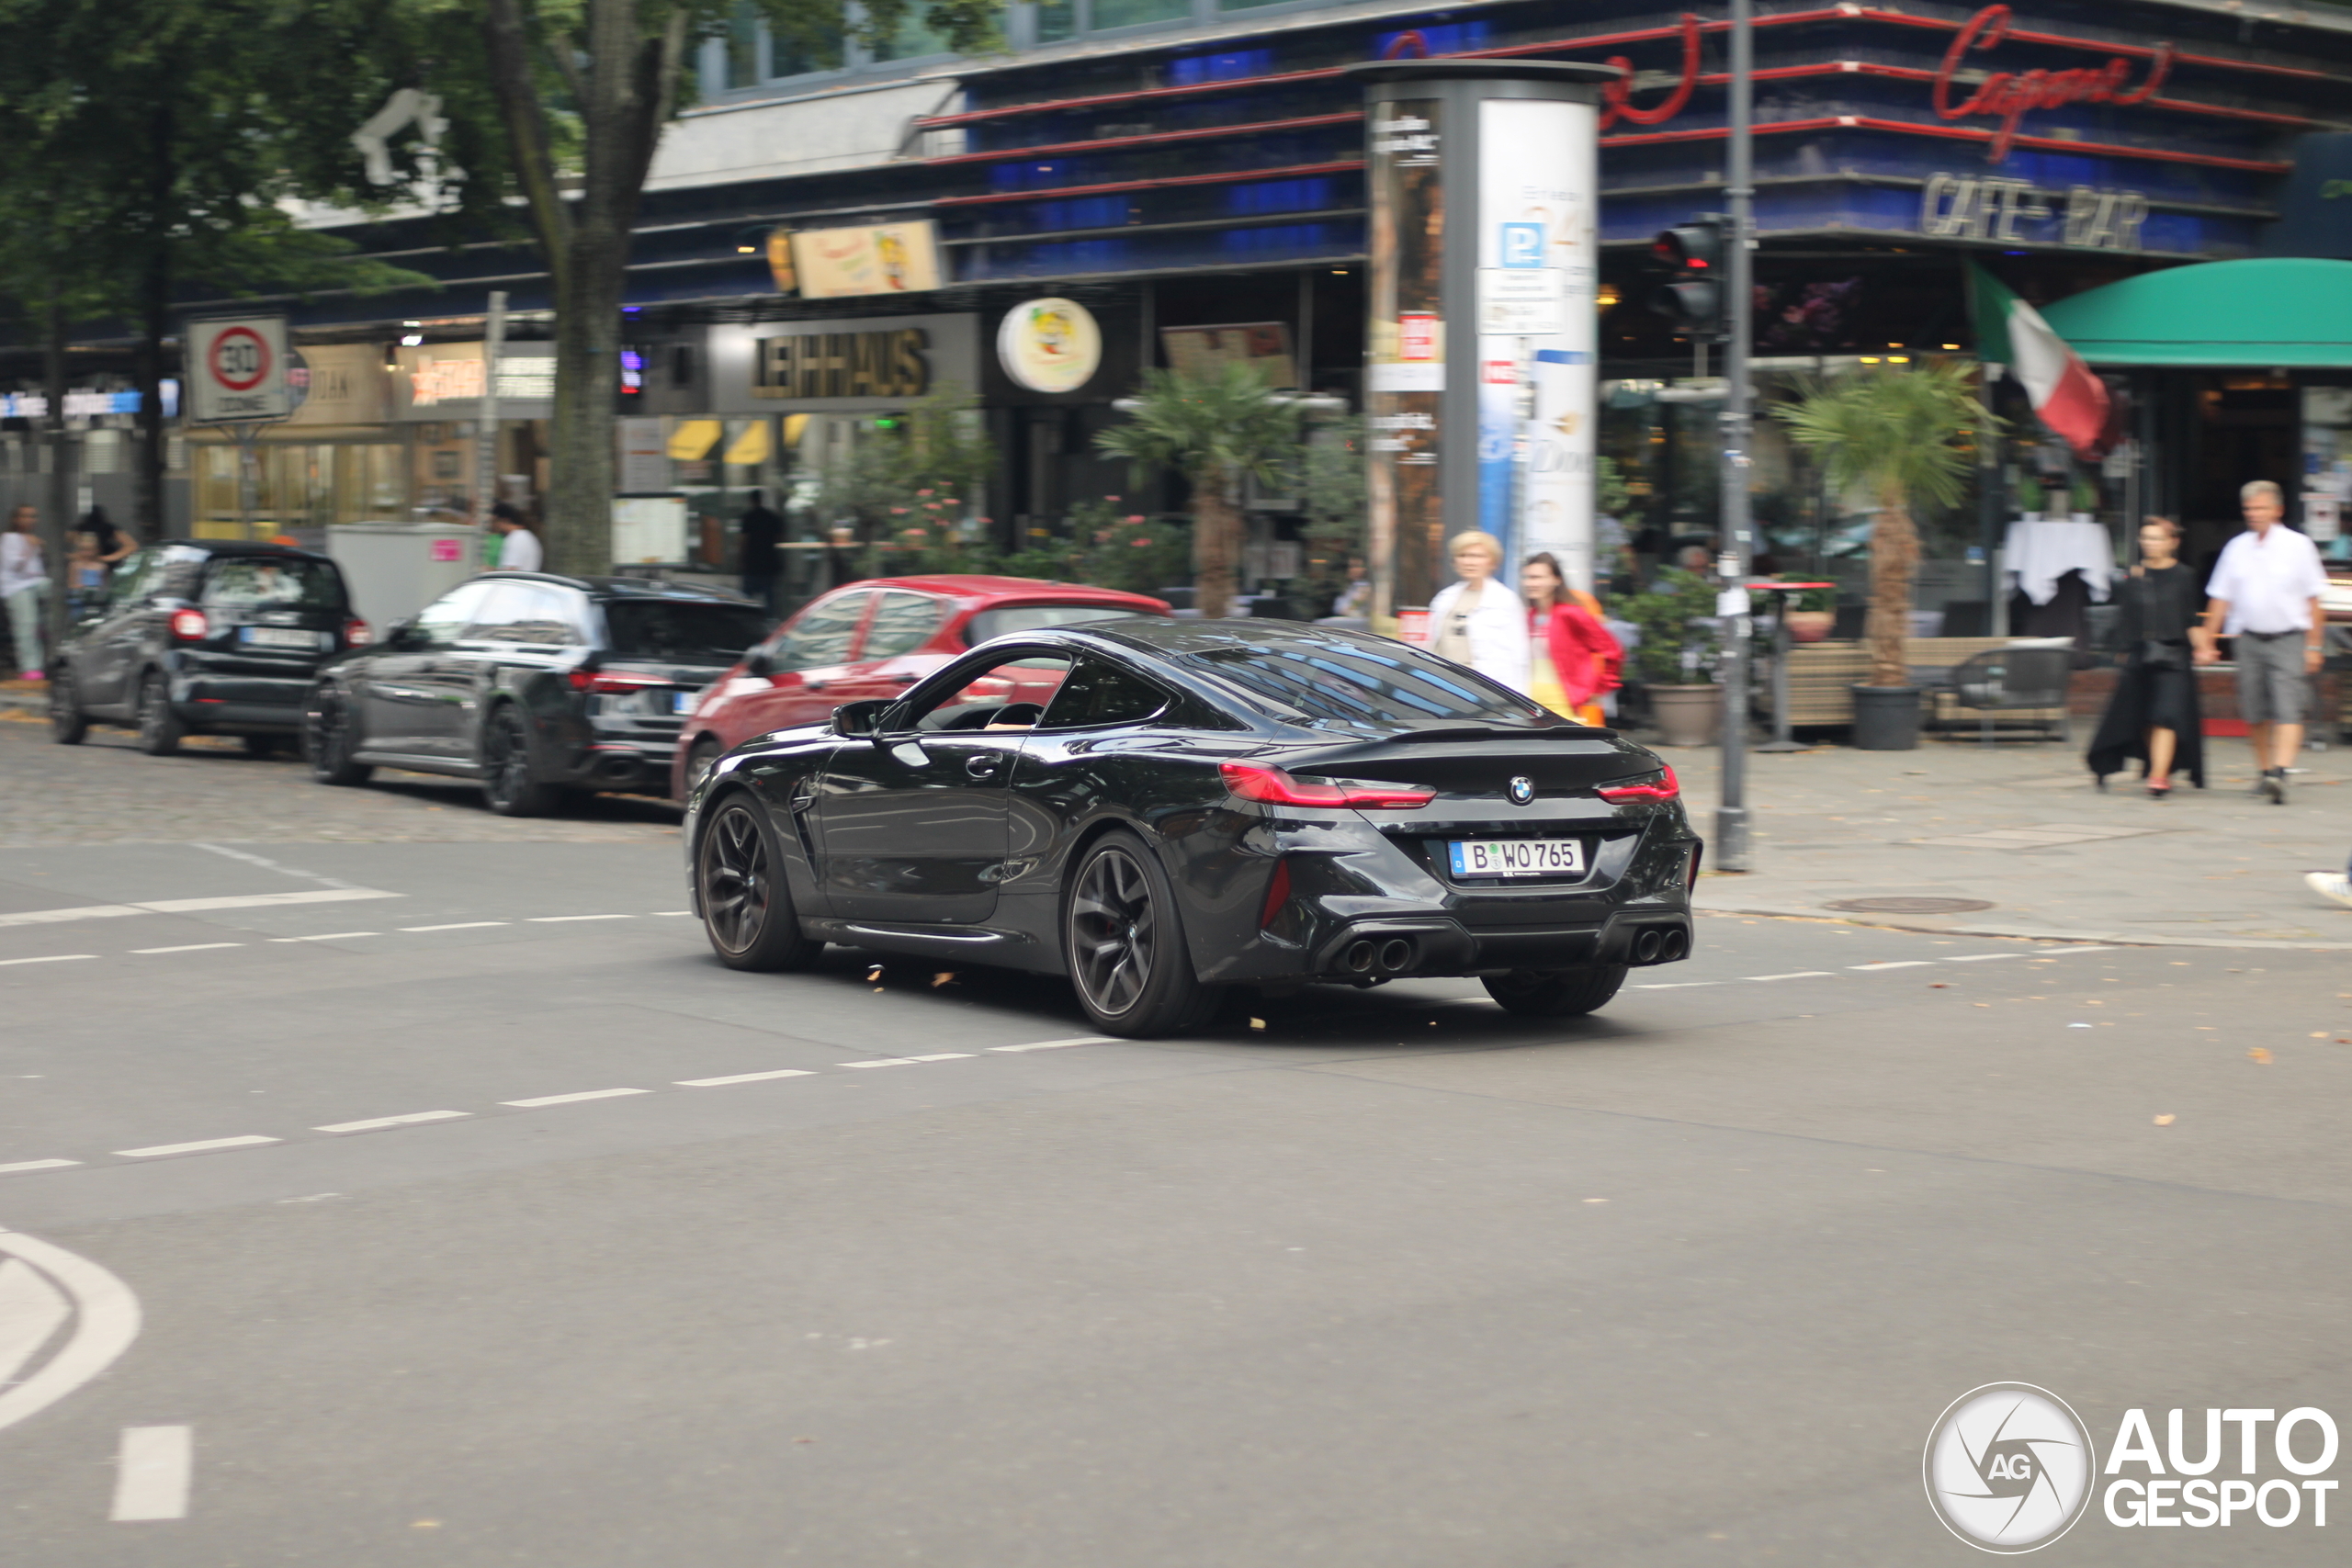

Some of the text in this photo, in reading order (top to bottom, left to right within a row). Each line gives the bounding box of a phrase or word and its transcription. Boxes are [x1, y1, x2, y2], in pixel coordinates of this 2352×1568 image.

[220, 344, 260, 373] 30
[1473, 843, 1574, 869] B WO 765
